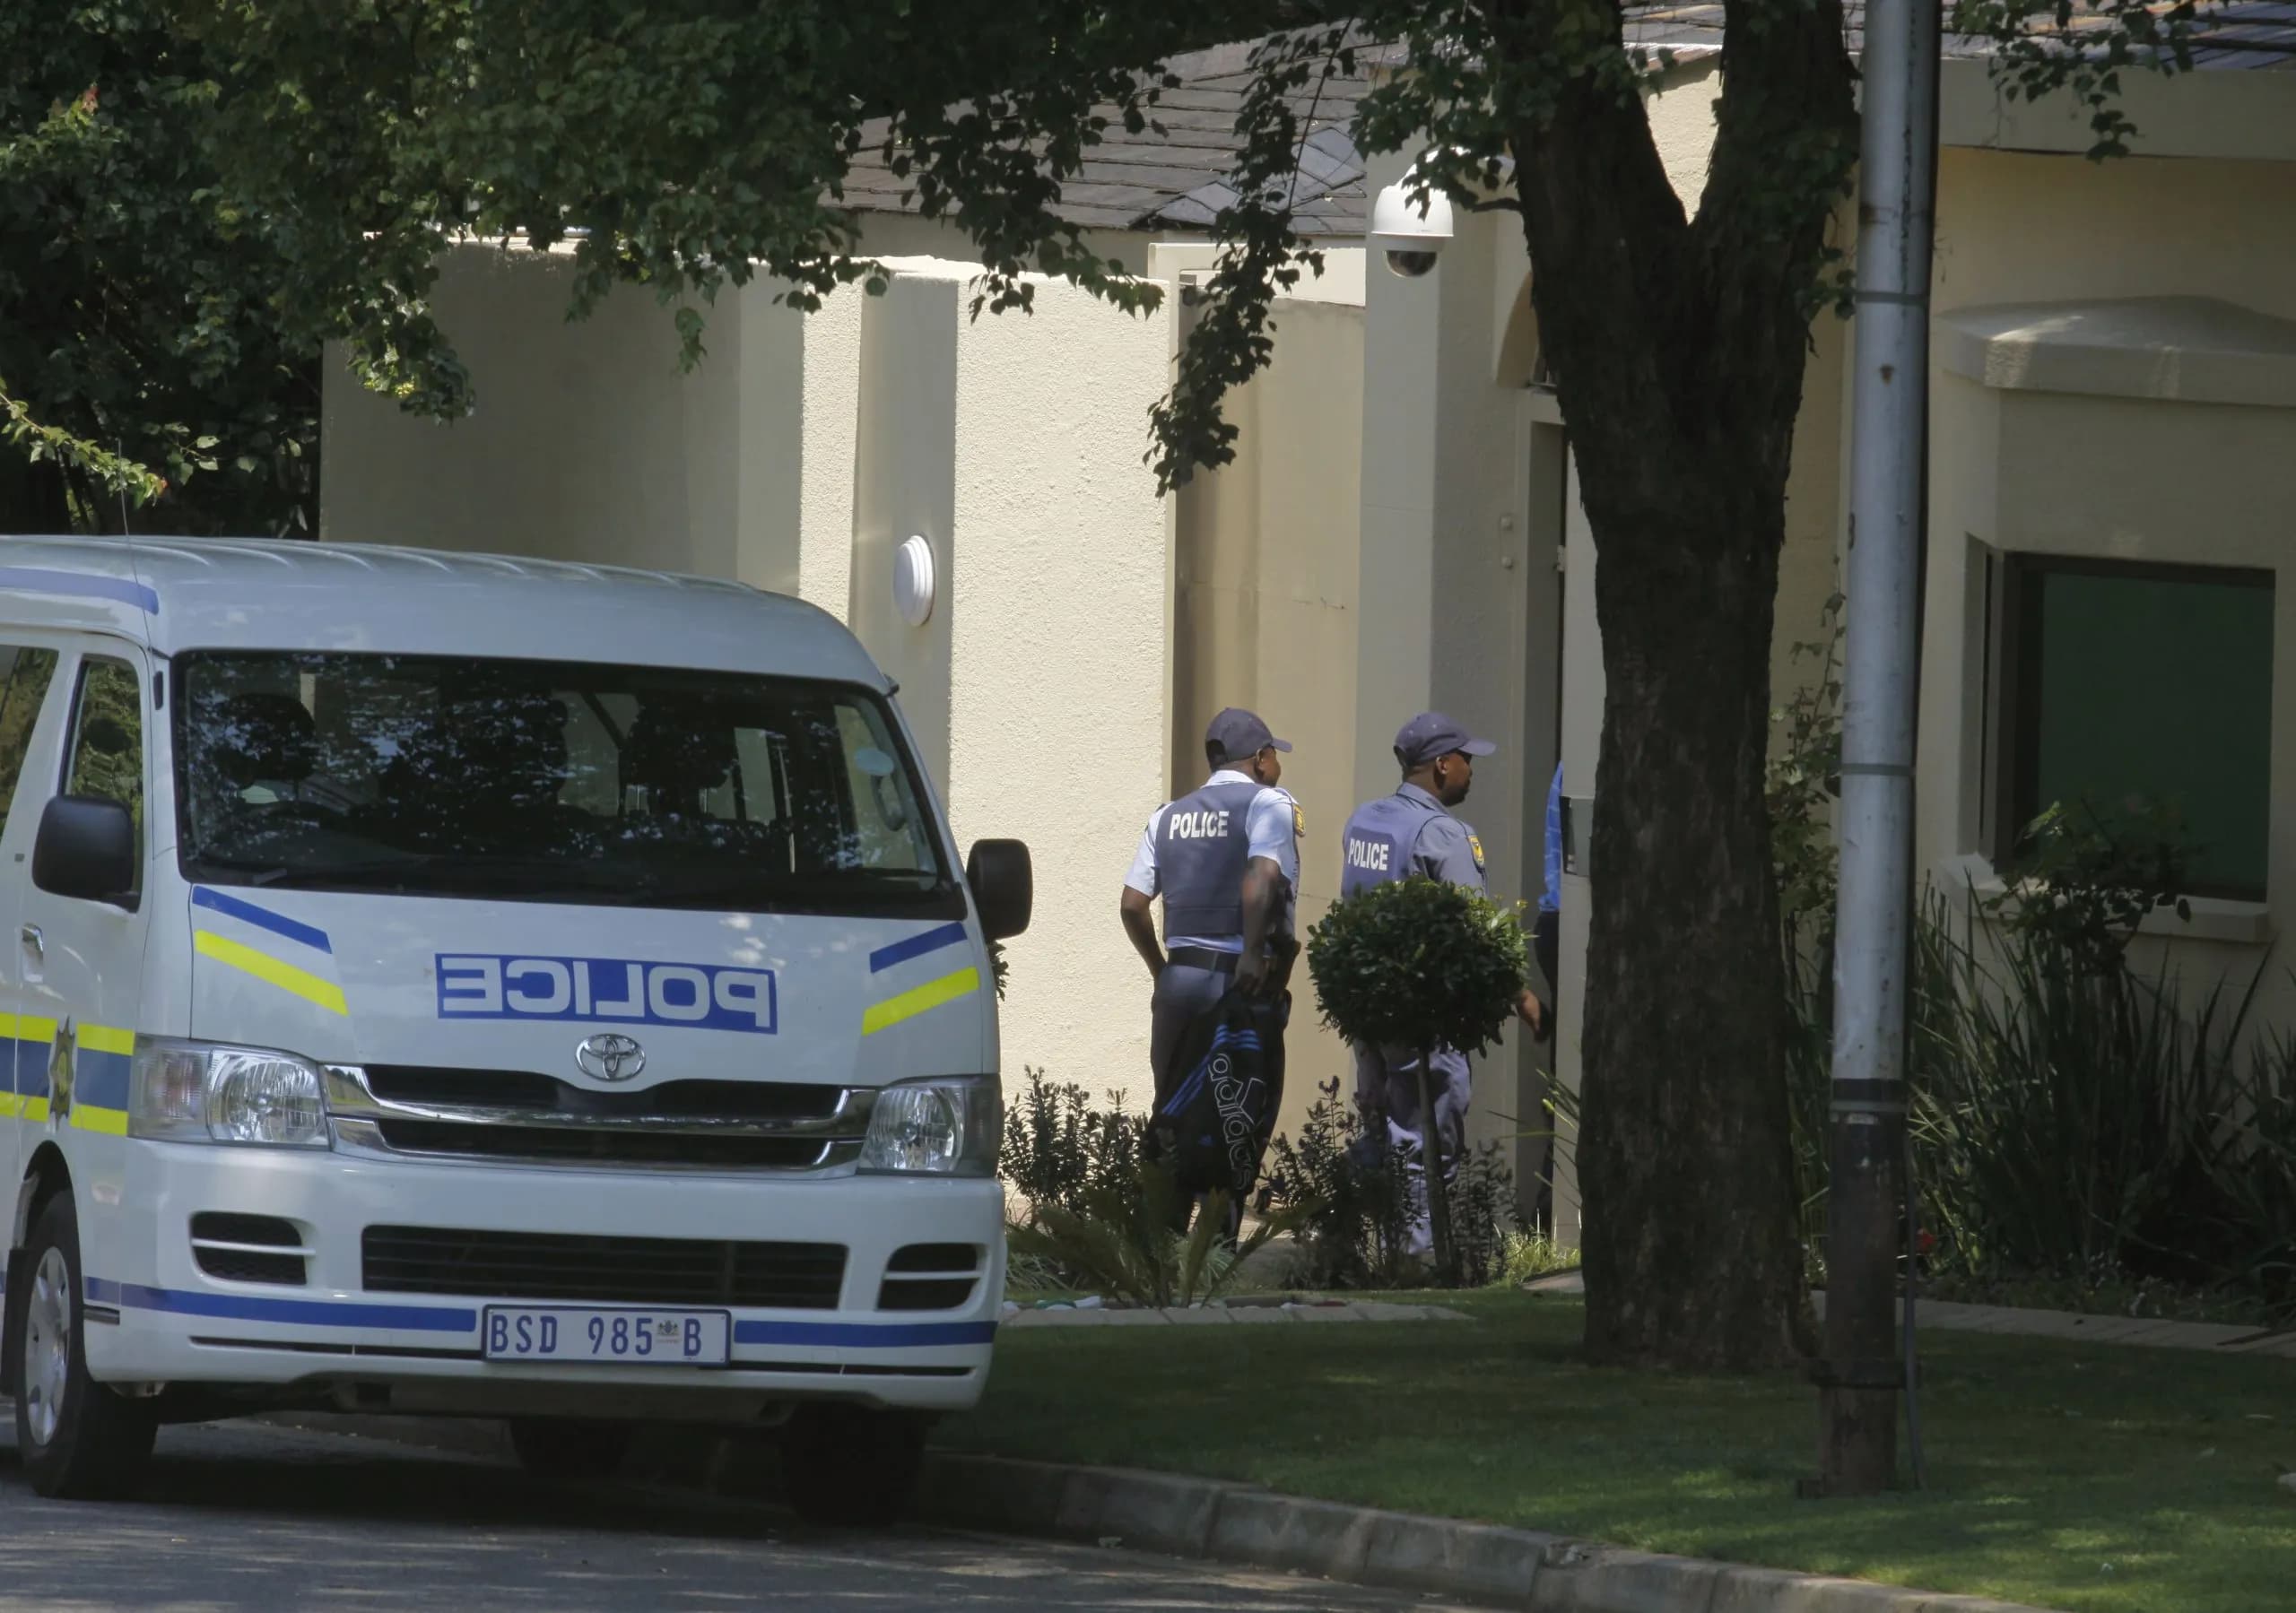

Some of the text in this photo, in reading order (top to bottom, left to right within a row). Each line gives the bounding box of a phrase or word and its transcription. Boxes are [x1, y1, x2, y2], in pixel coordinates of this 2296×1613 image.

[1170, 811, 1230, 840] POLICE
[1347, 837, 1389, 872] POLICE
[490, 1314, 702, 1357] BSD 985 B
